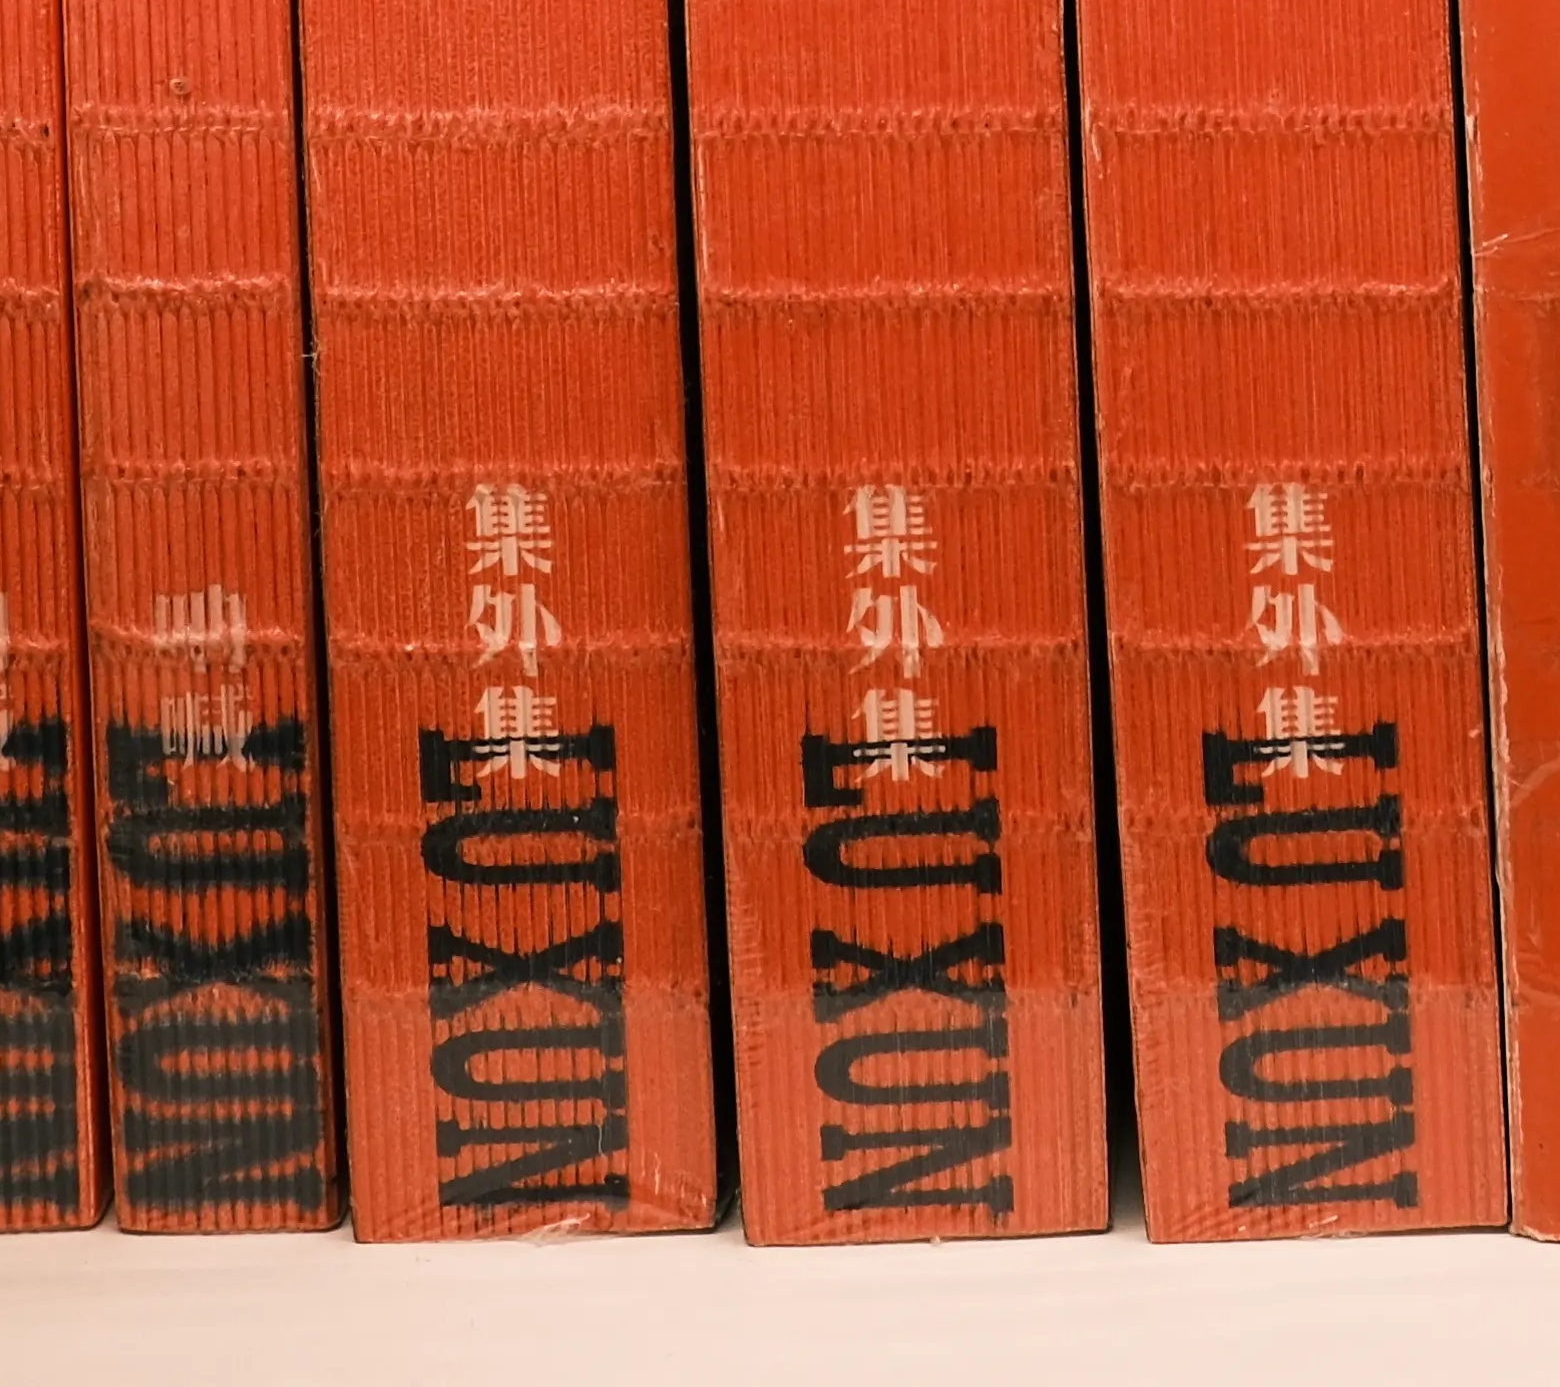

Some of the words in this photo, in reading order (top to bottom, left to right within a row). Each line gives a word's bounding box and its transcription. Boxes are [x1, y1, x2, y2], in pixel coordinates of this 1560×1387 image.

[464, 481, 563, 782] 集外集
[842, 483, 946, 783] 集外集
[1245, 481, 1347, 781] 集外集
[418, 722, 622, 895] LU
[801, 724, 1004, 896] LU
[1201, 721, 1405, 893] LU
[425, 923, 631, 1211] XUN
[809, 917, 1016, 1215] XUN
[1211, 916, 1420, 1211] XUN
